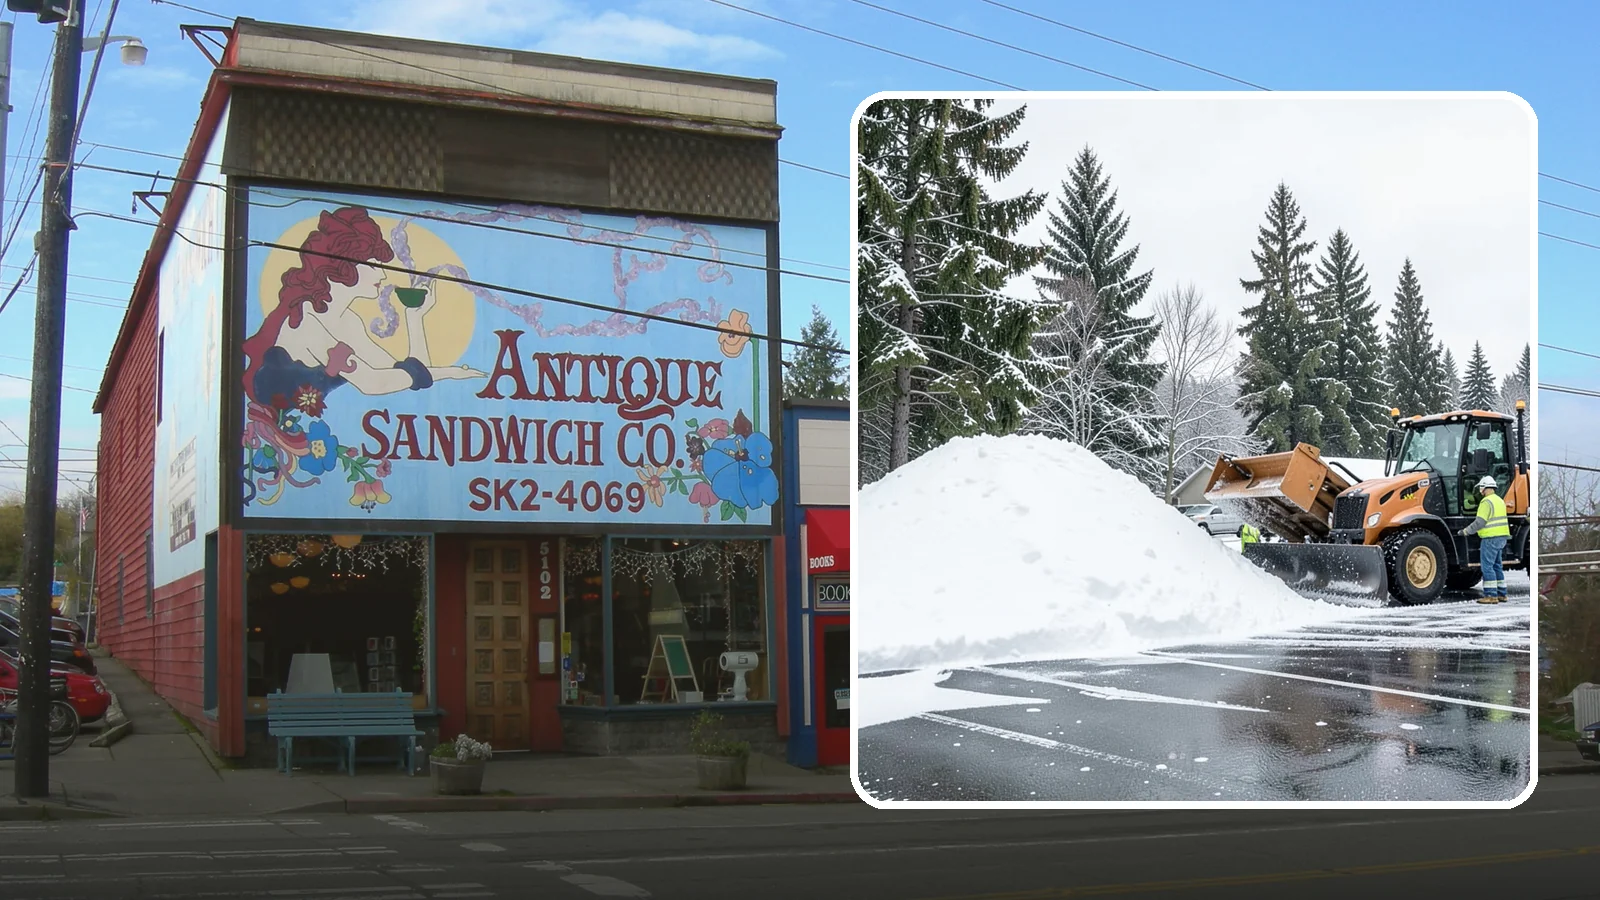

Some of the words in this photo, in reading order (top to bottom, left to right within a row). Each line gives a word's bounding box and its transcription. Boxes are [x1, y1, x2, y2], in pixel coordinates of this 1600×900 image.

[475, 329, 723, 421] ANTIQUE
[361, 408, 604, 467] SANDWICH
[617, 421, 685, 469] CO.
[468, 476, 646, 513] SK2-4069
[540, 541, 551, 599] 5102
[810, 555, 834, 569] BOOKS
